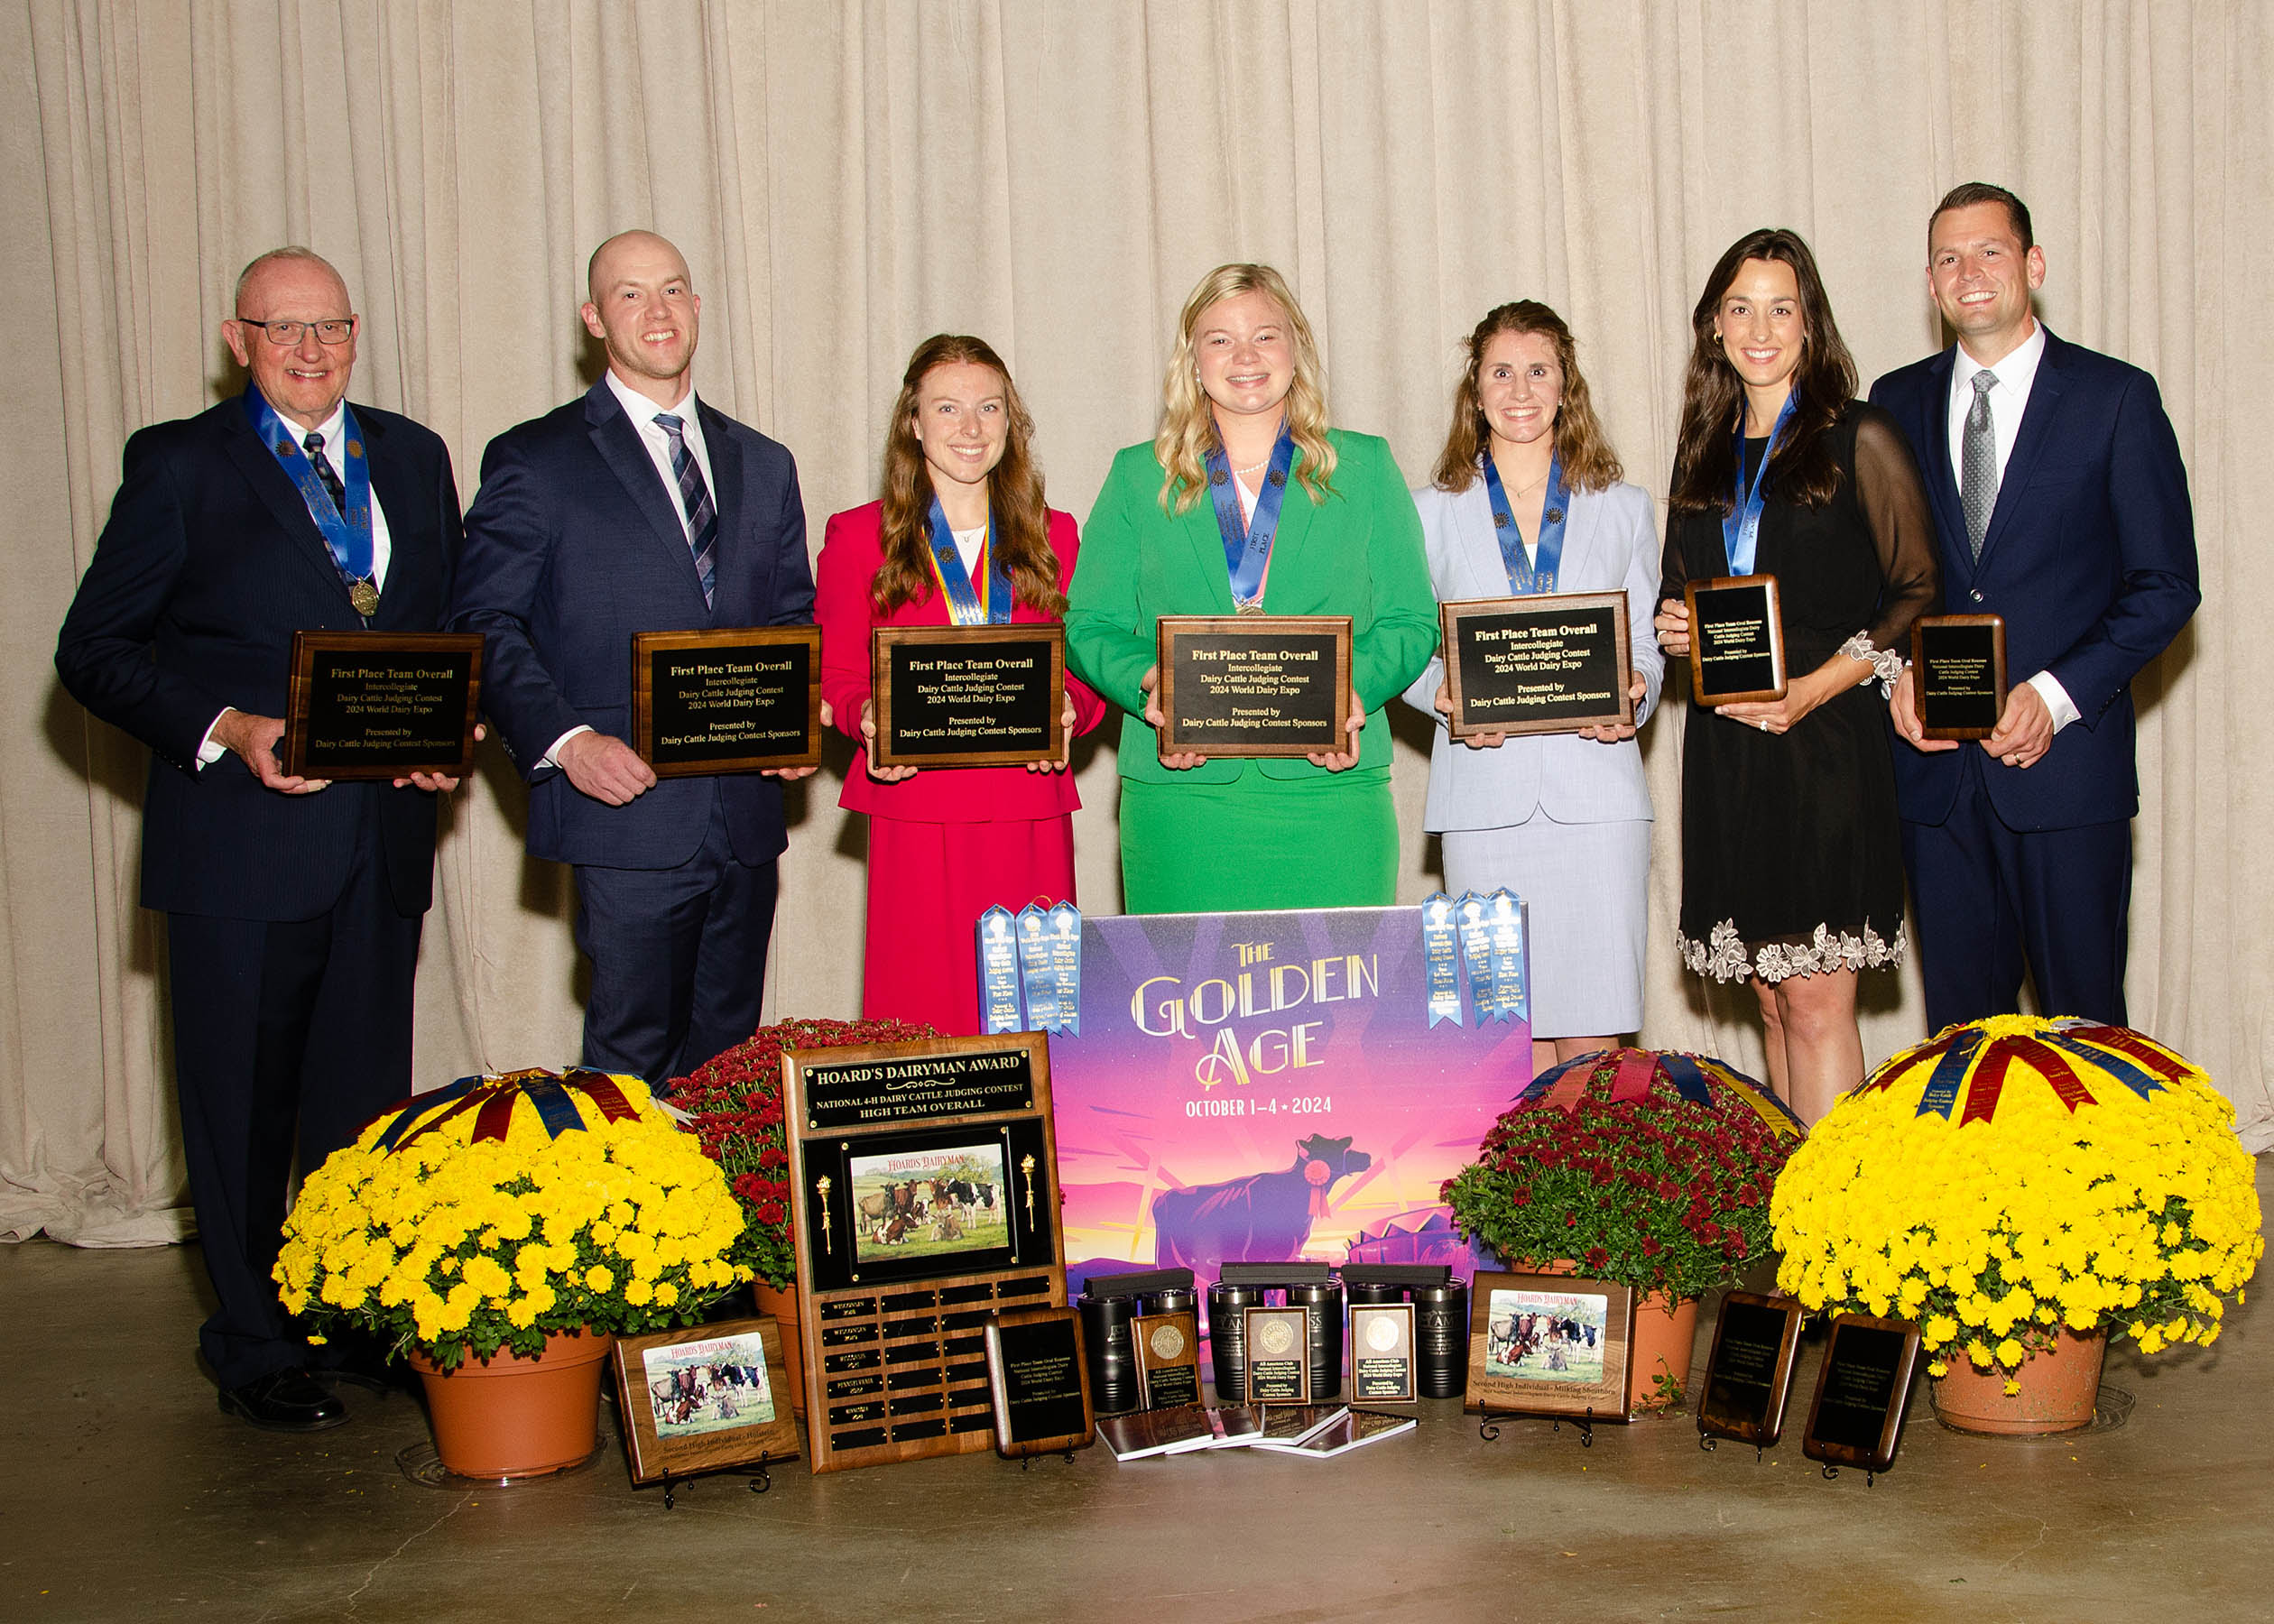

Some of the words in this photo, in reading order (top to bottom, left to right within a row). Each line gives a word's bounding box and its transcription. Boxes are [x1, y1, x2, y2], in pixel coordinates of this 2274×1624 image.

[1259, 533, 1270, 554] PLACE
[1475, 631, 1499, 641] First
[1502, 630, 1528, 639] Place
[1530, 628, 1558, 637] Team
[1559, 623, 1597, 635] Overall
[1511, 641, 1563, 651] Intercollegiate
[1192, 650, 1217, 660] First
[1219, 651, 1247, 660] Place
[1249, 651, 1277, 660] Team
[1280, 651, 1317, 660] Overall
[1485, 654, 1506, 663] Dairy
[1508, 652, 1530, 661] Cattle
[1531, 651, 1560, 660] Judging
[1562, 650, 1590, 658] Contest
[671, 667, 694, 676] First
[698, 665, 724, 674] Place
[726, 664, 753, 672] Team
[755, 661, 791, 671] Overall
[910, 661, 933, 670] First
[937, 660, 963, 669] Place
[966, 660, 993, 669] Team
[995, 659, 1032, 669] Overall
[1228, 664, 1282, 674] Intercollegiate
[1495, 664, 1513, 673] 2024
[1515, 662, 1538, 671] World
[1539, 661, 1560, 670] Dairy
[1562, 660, 1582, 669] Expo
[332, 669, 355, 678] First
[358, 669, 384, 678] Place
[387, 669, 413, 678] Team
[416, 669, 452, 678] Overall
[946, 673, 998, 682] Intercollegiate
[706, 677, 758, 686] Intercollegiate
[1201, 675, 1223, 685] Dairy
[1224, 675, 1247, 683] Cattle
[1249, 675, 1279, 685] Judging
[1280, 675, 1308, 683] Contest
[365, 683, 418, 692] Intercollegiate
[918, 686, 938, 694] Dairy
[965, 684, 994, 693] Judging
[1210, 686, 1229, 694] 2024
[1231, 686, 1254, 694] World
[1256, 686, 1278, 696] Dairy
[1280, 686, 1299, 696] Expo
[1518, 683, 1553, 693] Presented
[1555, 683, 1565, 692] by
[337, 694, 358, 704] Dairy
[360, 695, 383, 703] Cattle
[384, 694, 412, 704] Judging
[679, 691, 699, 699] Dairy
[702, 689, 724, 697] Cattle
[726, 688, 754, 697] Judging
[709, 699, 731, 707] World
[734, 698, 753, 707] Dairy
[755, 698, 774, 706] Expo
[928, 696, 946, 704] 2024
[948, 695, 970, 703] World
[973, 695, 994, 704] Dairy
[996, 695, 1015, 703] Expo
[1471, 698, 1492, 707] Dairy
[1493, 697, 1515, 706] Cattle
[1517, 695, 1546, 705] Judging
[1548, 694, 1576, 702] Contest
[1577, 692, 1611, 701] Sponsors
[391, 706, 410, 715] Dairy
[414, 706, 432, 715] Expo
[1233, 707, 1269, 715] Presented
[1271, 707, 1280, 717] by
[710, 721, 744, 730] Presented
[747, 721, 755, 729] by
[949, 716, 984, 724] Presented
[986, 716, 995, 725] by
[1182, 718, 1205, 728] Dairy
[1206, 718, 1229, 726] Cattle
[1230, 718, 1260, 728] Judging
[1293, 719, 1326, 728] Sponsors
[402, 729, 411, 737] by
[900, 729, 921, 738] Dairy
[948, 727, 976, 737] Judging
[1008, 726, 1041, 735] Sponsors
[661, 736, 682, 745] Dairy
[684, 734, 706, 743] Cattle
[708, 734, 736, 743] Judging
[768, 731, 800, 739] Sponsors
[316, 740, 337, 749] Dairy
[363, 740, 392, 749] Judging
[1231, 941, 1274, 967] THE
[1131, 954, 1378, 1039] GOLDEN
[1196, 1021, 1325, 1091] AGE
[818, 1068, 883, 1084] HOARD'S
[886, 1061, 965, 1078] DAIRYMAN
[969, 1055, 1020, 1071] AWARD
[817, 1098, 863, 1109] NATIONAL
[880, 1094, 907, 1103] DAIRY
[909, 1091, 942, 1101] CATTLE
[945, 1088, 983, 1097] JUDGING
[984, 1084, 1023, 1093] CONTEST
[860, 1108, 891, 1118] HIGH
[893, 1104, 927, 1114] TEAM
[930, 1100, 984, 1112] OVERALL
[1186, 1100, 1244, 1117] OCTOBER
[1292, 1096, 1332, 1113] 2024
[922, 1155, 965, 1169] DAIRYMAN
[1544, 1294, 1578, 1306] DAIRYMAN
[698, 1341, 733, 1356] DAIRYMAN
[1497, 1381, 1513, 1390] High
[1555, 1385, 1581, 1394] Milking
[664, 1444, 688, 1453] Second
[689, 1440, 706, 1450] High
